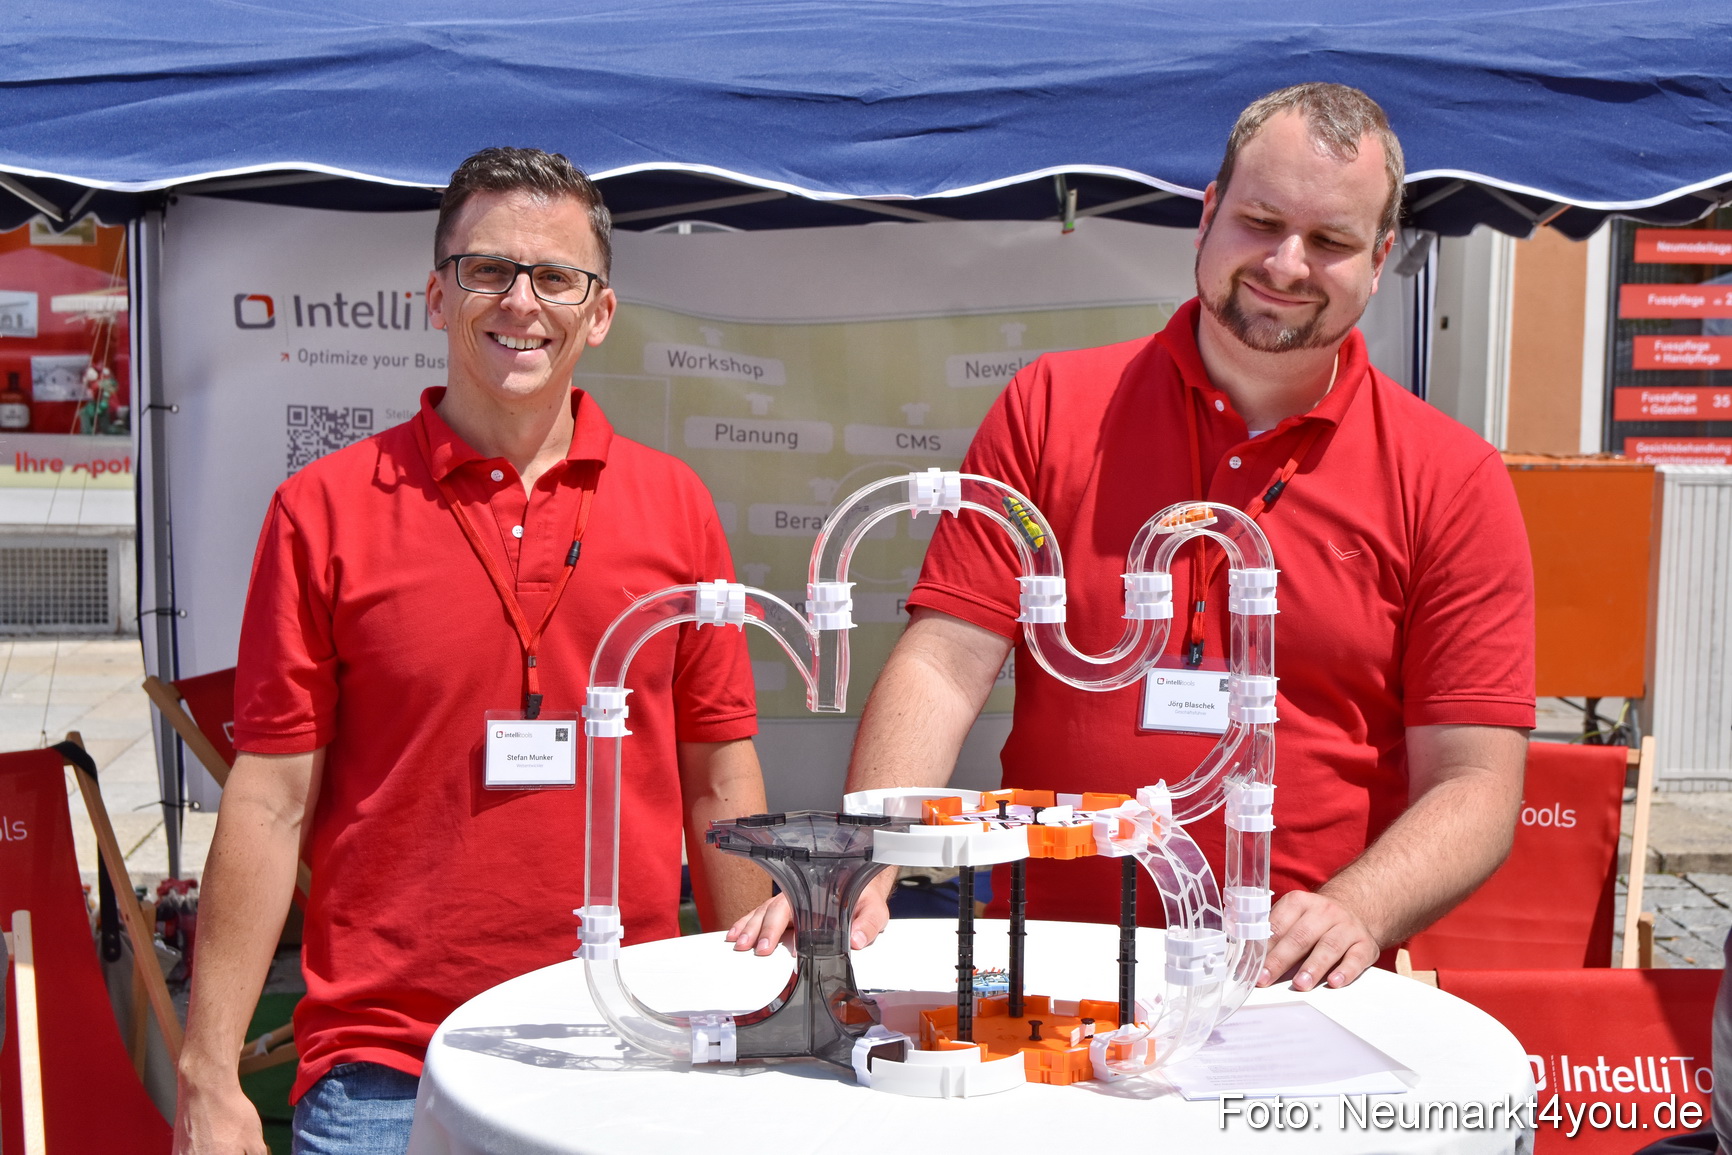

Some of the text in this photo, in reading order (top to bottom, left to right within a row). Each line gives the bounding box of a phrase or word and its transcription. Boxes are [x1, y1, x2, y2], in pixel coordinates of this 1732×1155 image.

[293, 290, 429, 332] IntelliT
[1647, 293, 1706, 308] Fusspflege
[1654, 340, 1711, 353] Fusspflege
[297, 348, 368, 367] Optimize
[372, 353, 409, 369] your
[667, 350, 764, 380] Workshop
[1662, 352, 1720, 365] Handpflege
[1641, 391, 1731, 408] Fusspflege 35
[715, 423, 798, 450] Planung
[896, 433, 941, 451] CMS
[15, 451, 64, 473] Ihre
[1168, 701, 1216, 710] Jörg Blaschek
[1521, 800, 1577, 828] ools
[0, 815, 28, 841] ls
